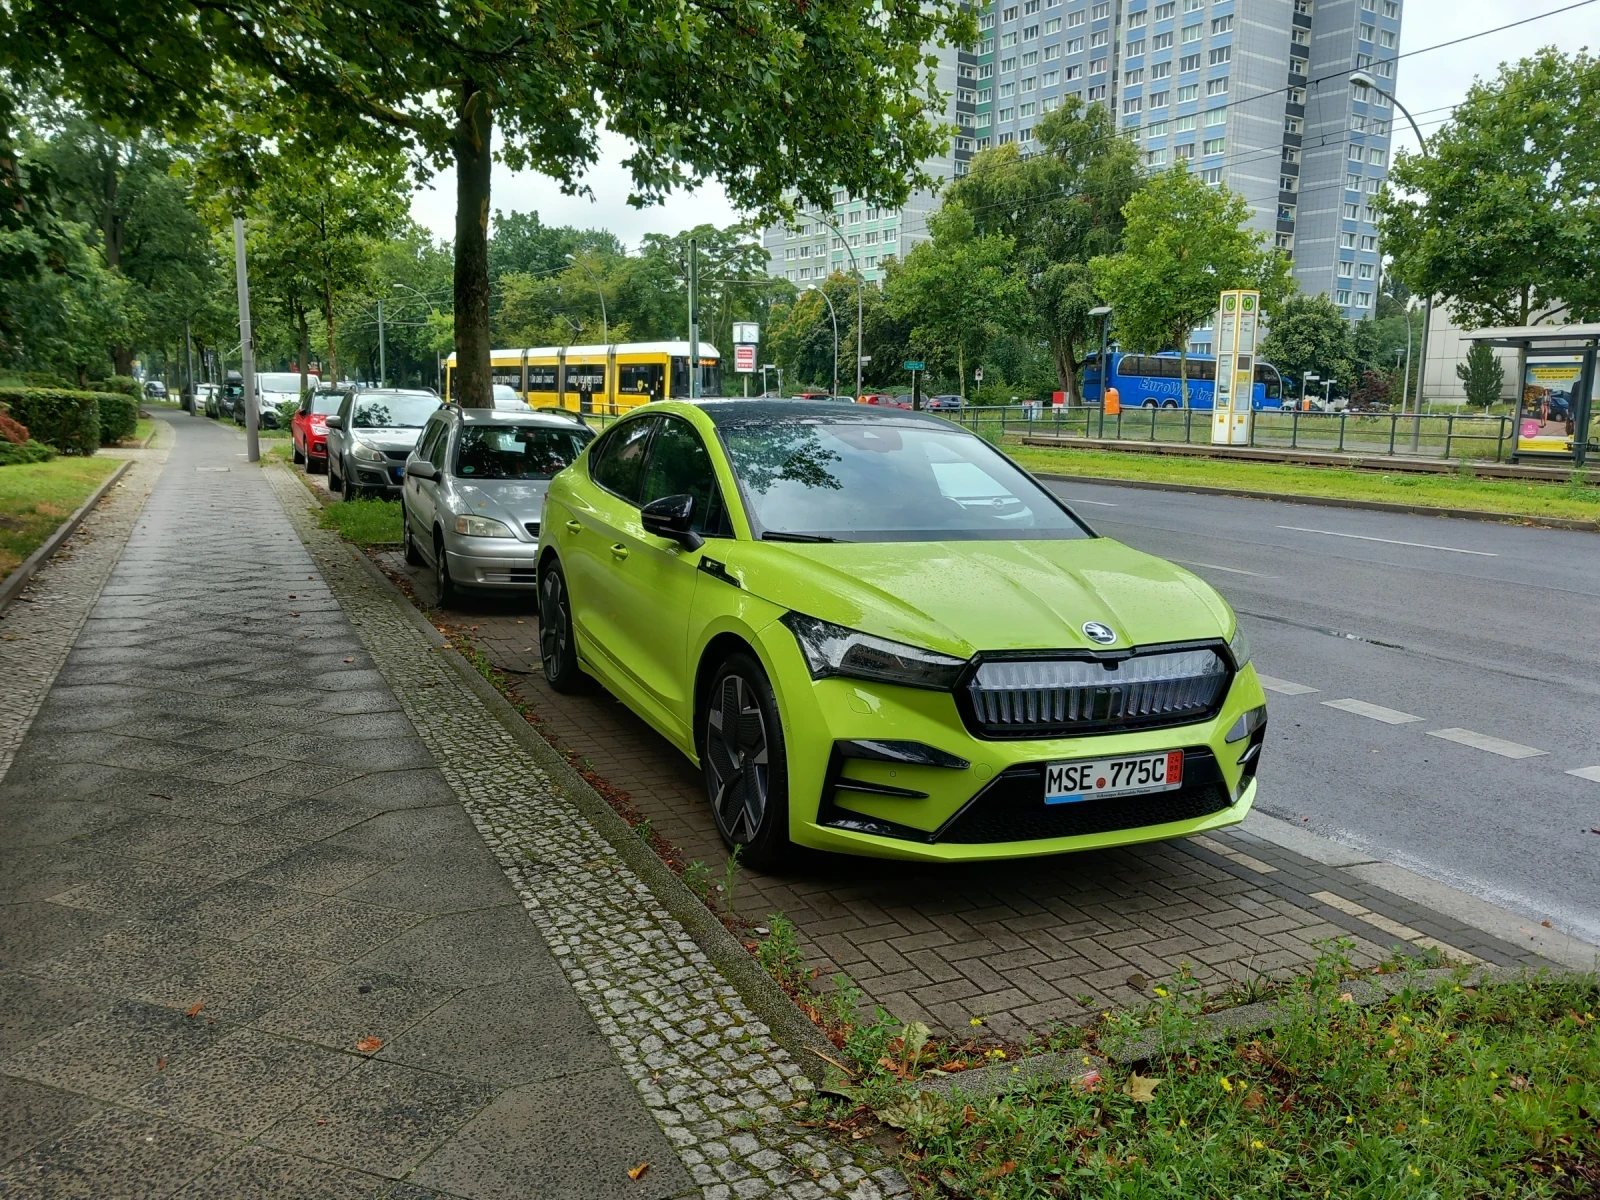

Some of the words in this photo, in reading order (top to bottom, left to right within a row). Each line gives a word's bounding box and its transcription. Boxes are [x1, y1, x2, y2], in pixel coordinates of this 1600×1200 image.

[1139, 377, 1194, 398] EuroWn
[1047, 765, 1094, 793] MSE
[1110, 757, 1165, 787] 775C
